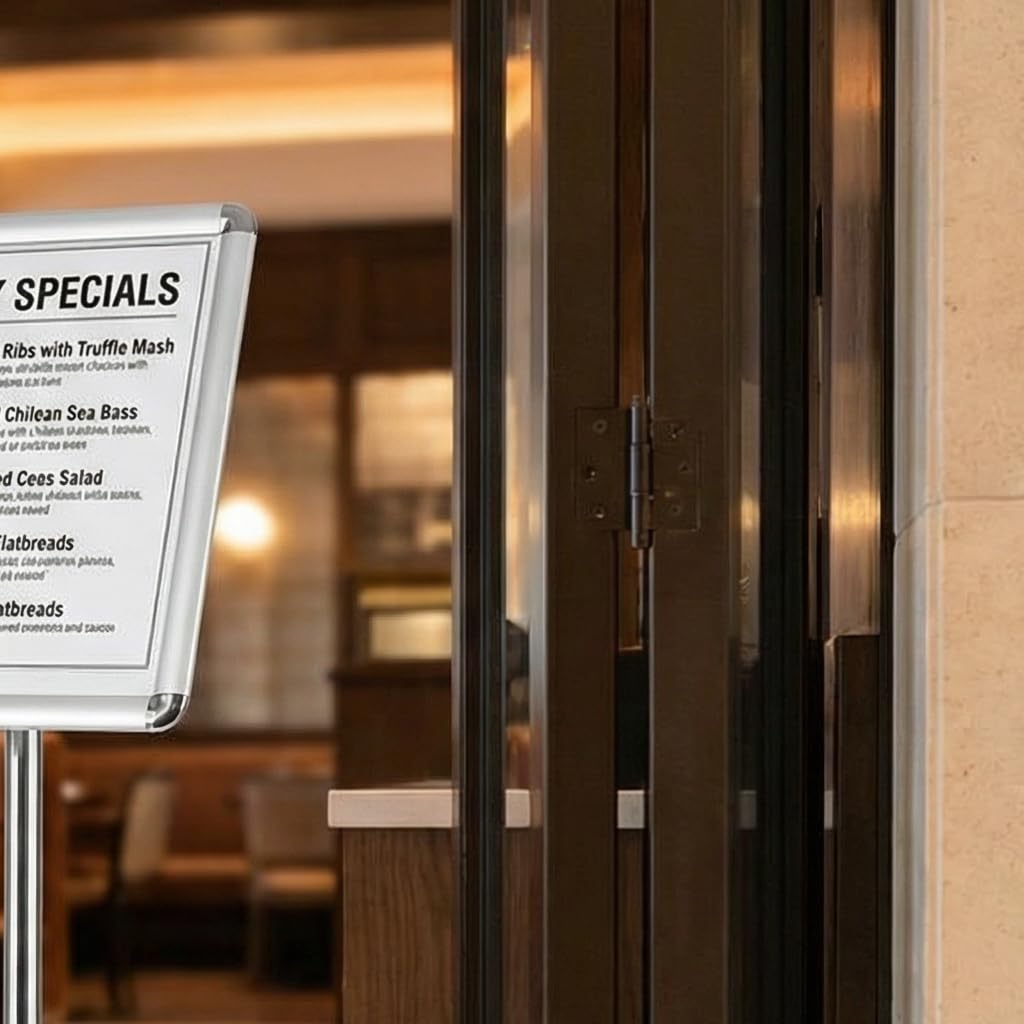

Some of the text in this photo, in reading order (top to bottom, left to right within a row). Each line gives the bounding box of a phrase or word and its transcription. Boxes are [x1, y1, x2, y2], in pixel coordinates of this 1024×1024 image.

[14, 272, 180, 312] SPECIALS
[2, 342, 37, 359] Ribs
[40, 341, 73, 358] with
[77, 339, 128, 357] Truffle
[131, 337, 175, 355] Mash
[4, 405, 62, 422] Chilean
[66, 404, 96, 421] Sea
[100, 404, 139, 420] Bass
[59, 469, 104, 485] Salad
